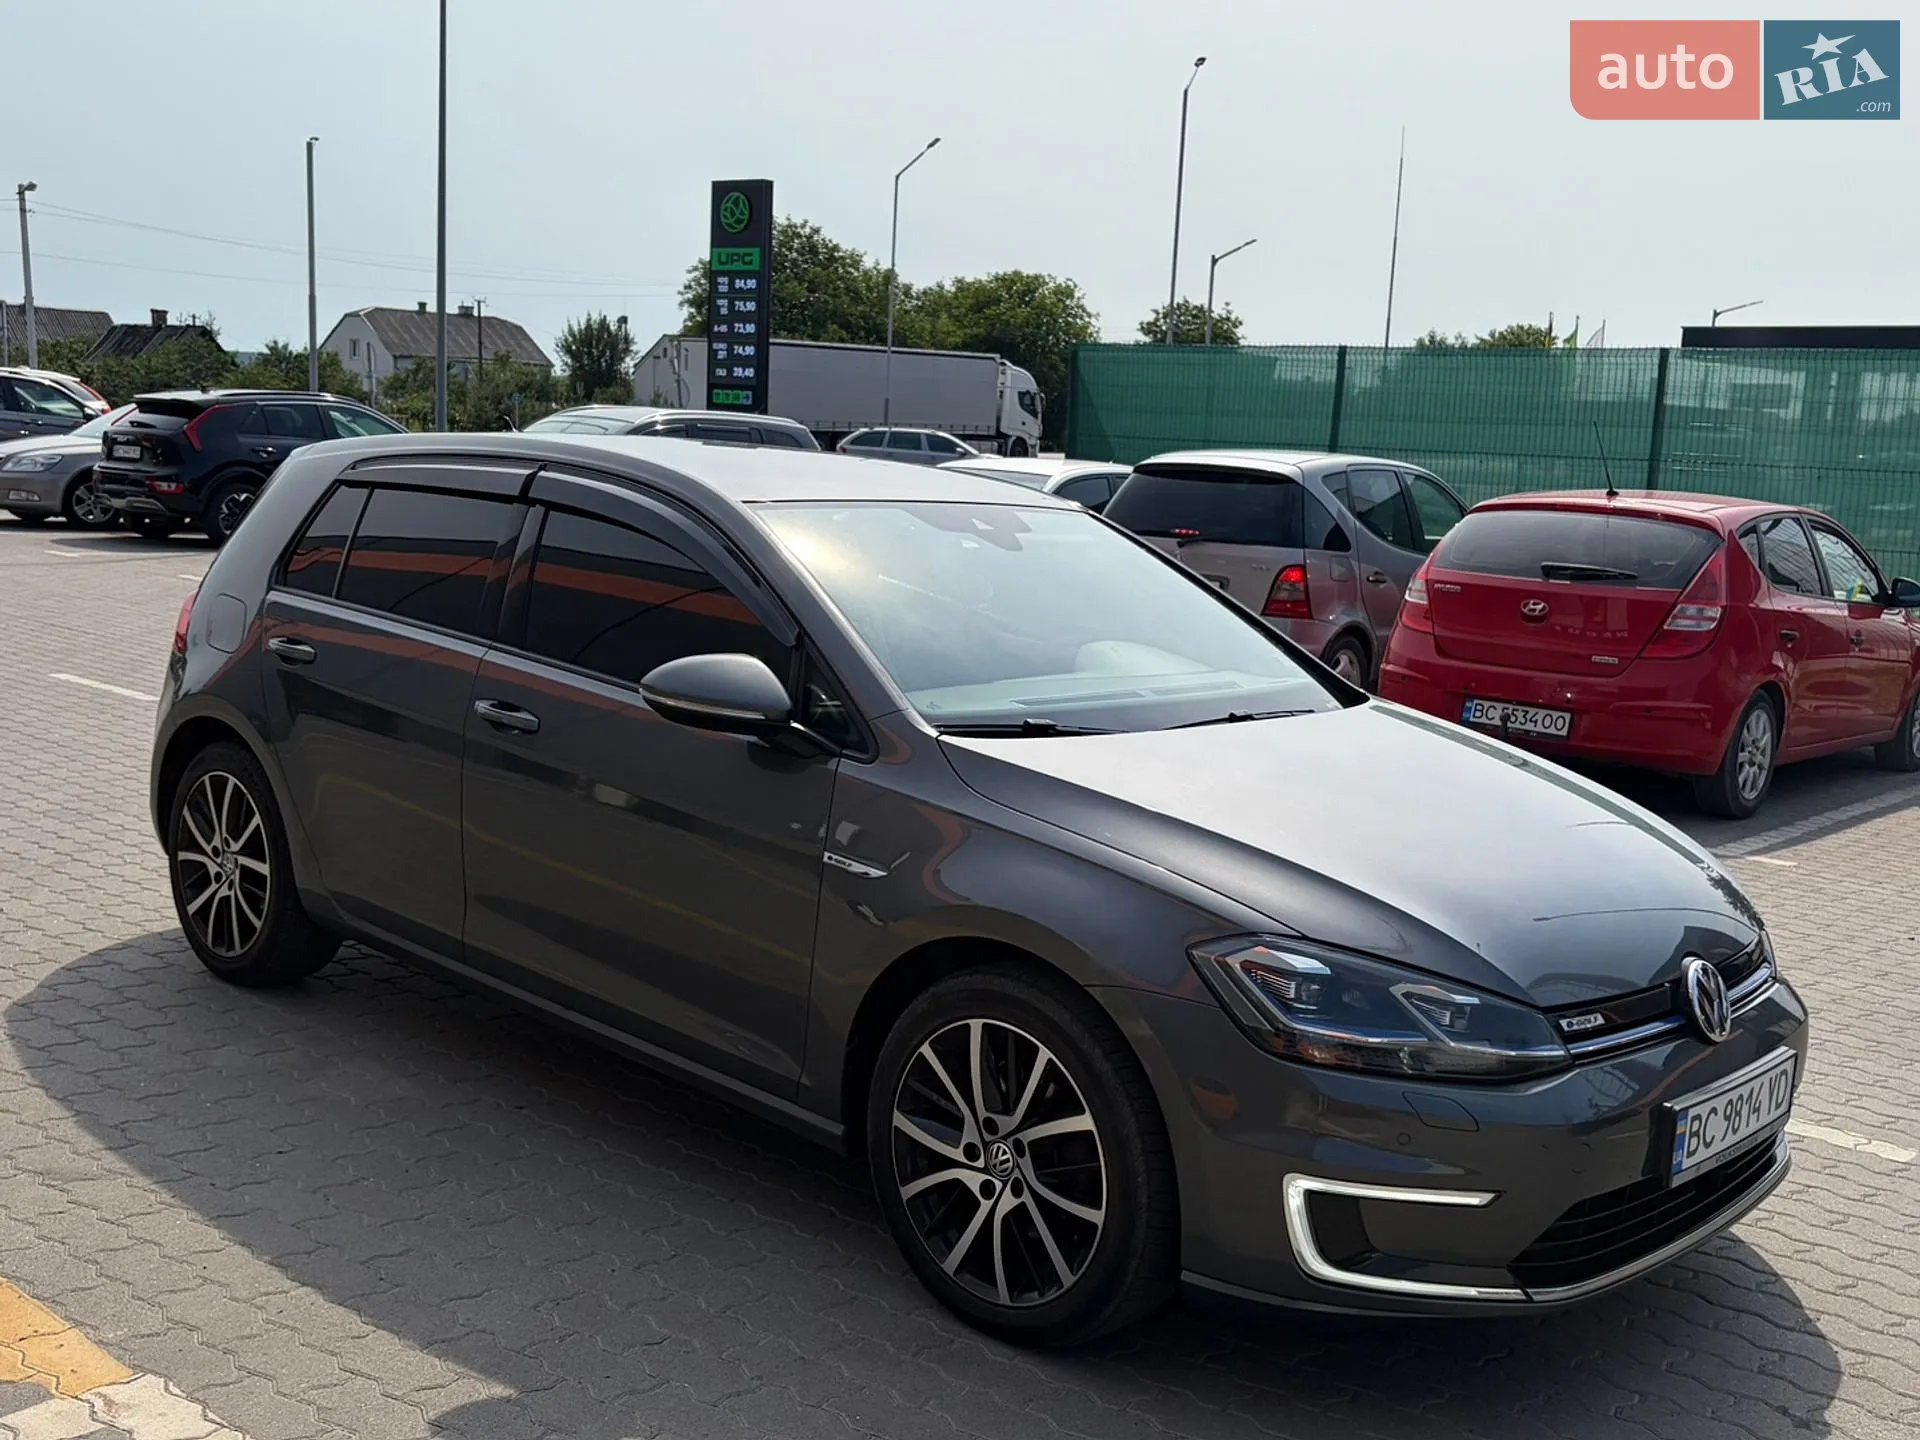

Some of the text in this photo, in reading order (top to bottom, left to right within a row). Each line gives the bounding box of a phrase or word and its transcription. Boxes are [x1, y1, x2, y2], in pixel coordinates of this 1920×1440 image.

[717, 251, 754, 266] UPG
[734, 278, 757, 290] 84,90
[733, 323, 756, 334] 73,90
[1473, 703, 1497, 721] BC
[1686, 1106, 1718, 1160] BC
[1720, 1081, 1765, 1142] 9814
[1767, 1068, 1789, 1116] YD
